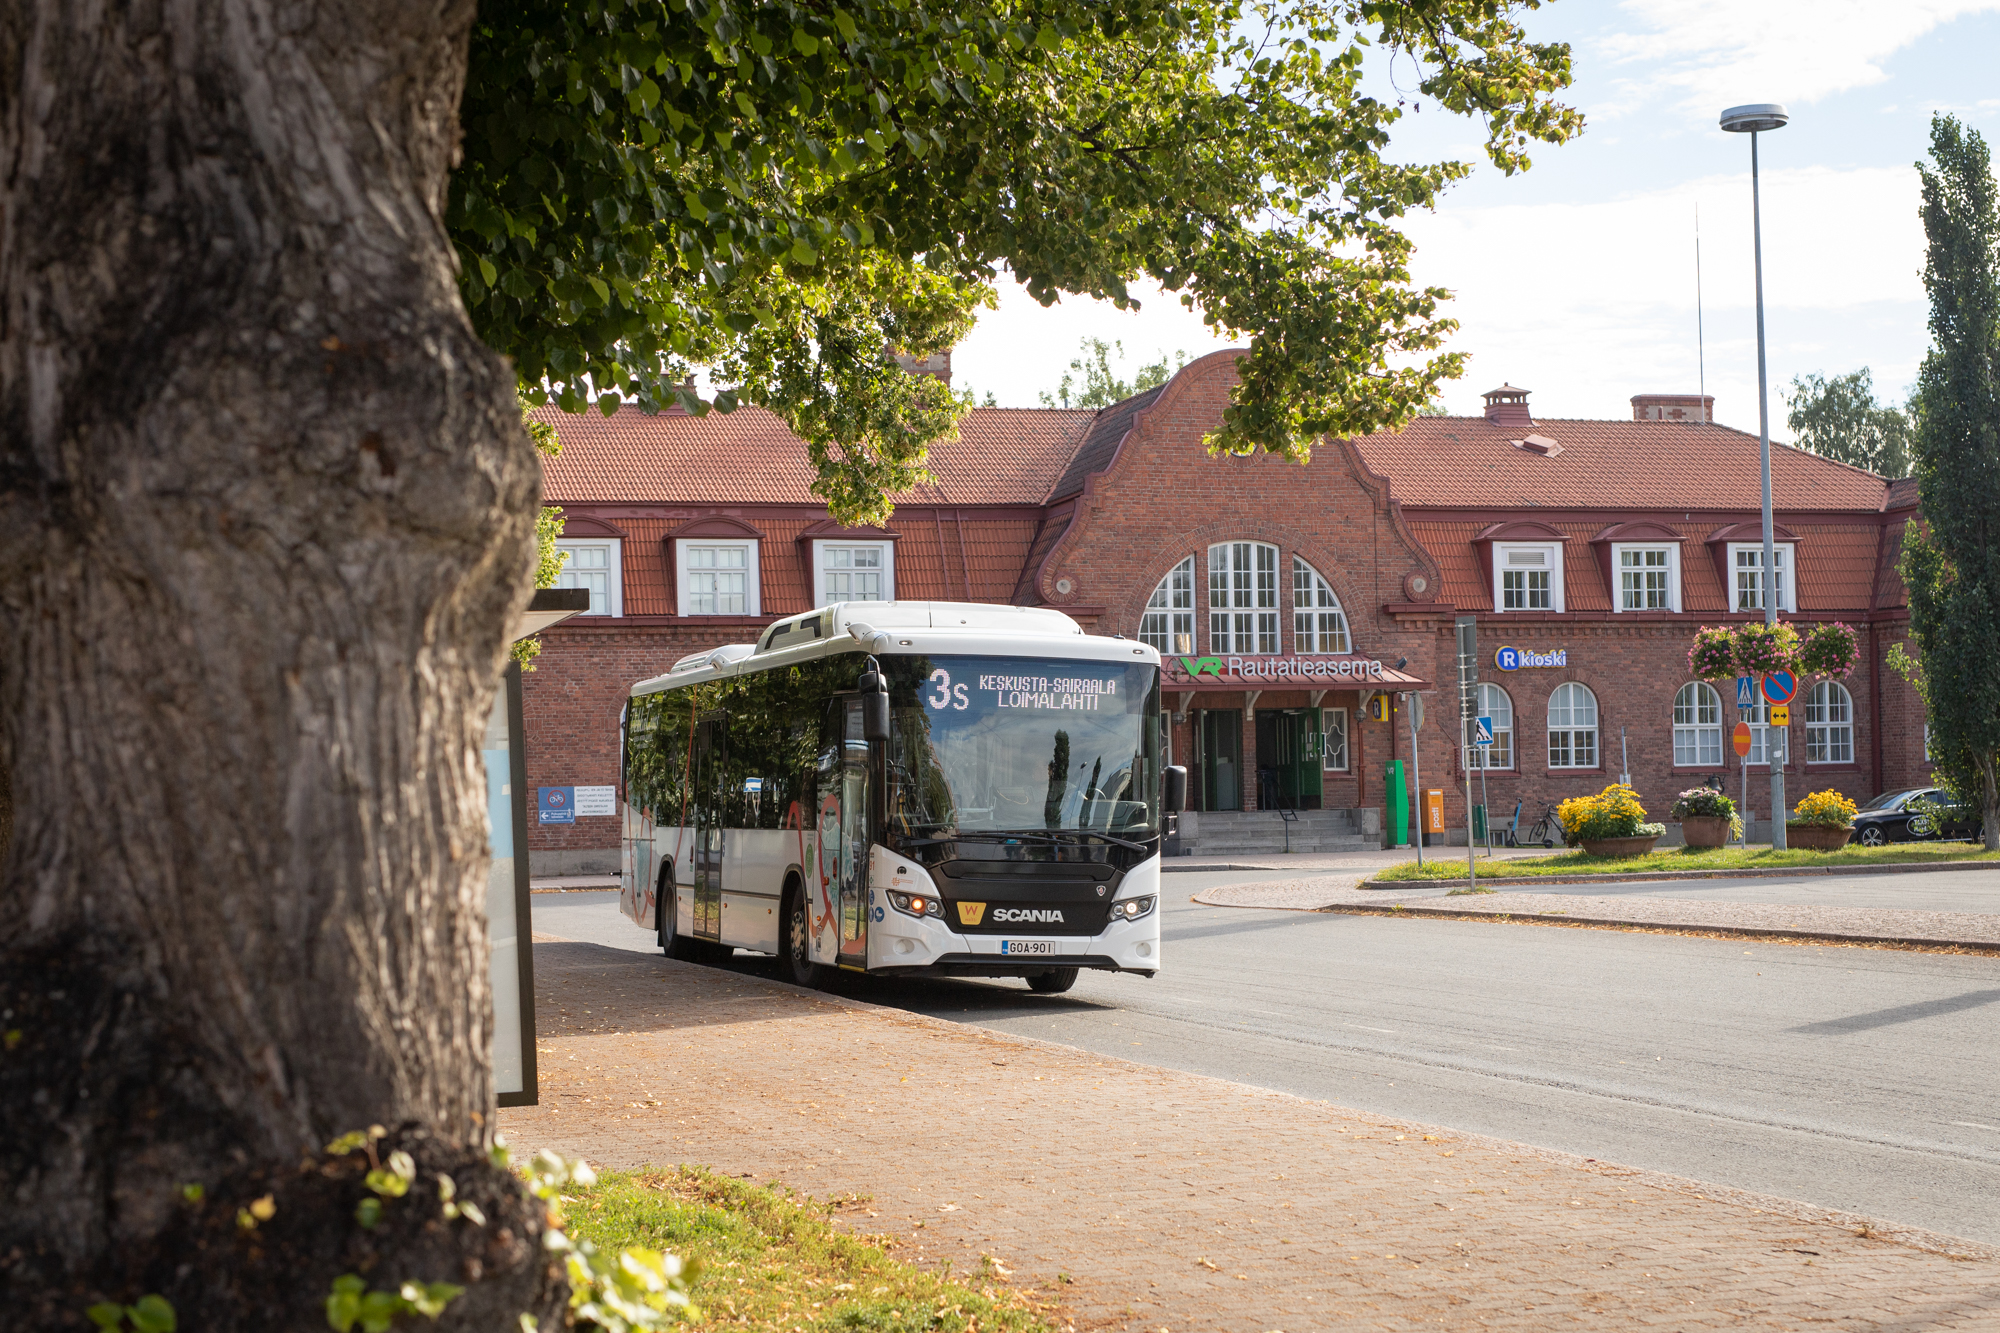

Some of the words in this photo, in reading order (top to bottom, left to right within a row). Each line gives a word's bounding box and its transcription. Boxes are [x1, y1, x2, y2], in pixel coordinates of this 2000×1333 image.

[1180, 657, 1223, 677] VR
[1228, 656, 1383, 677] Rautatieasema
[1521, 650, 1567, 667] kioski
[979, 674, 1116, 695] KESKUSTA-SAIRAALA
[998, 691, 1098, 711] LOIMALAHTI
[1432, 807, 1441, 828] posti
[965, 905, 978, 916] W
[993, 908, 1065, 923] SCANIA
[1009, 942, 1051, 953] GOA-901
